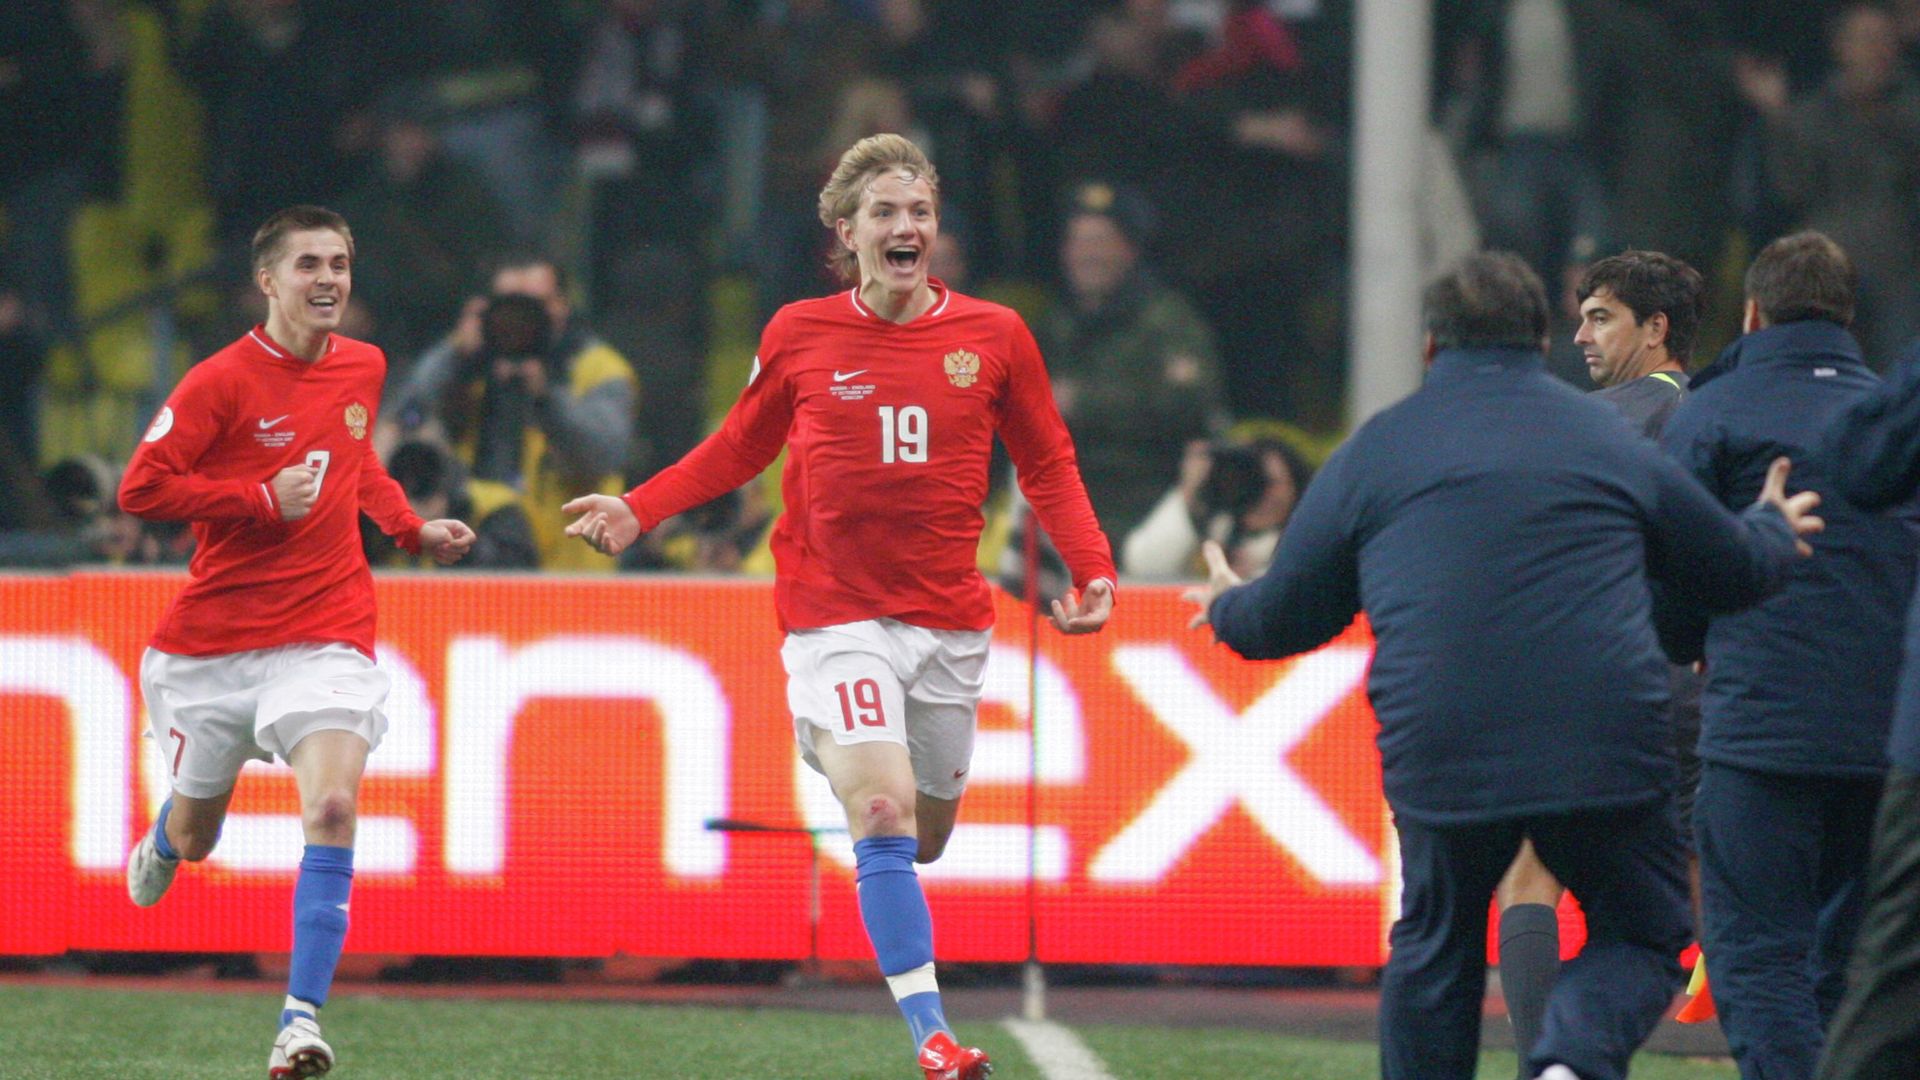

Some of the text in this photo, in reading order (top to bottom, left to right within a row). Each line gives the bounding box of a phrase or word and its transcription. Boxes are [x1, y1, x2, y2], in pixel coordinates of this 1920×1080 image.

[878, 405, 928, 464] 19
[834, 678, 887, 732] 19
[169, 727, 186, 778] 7
